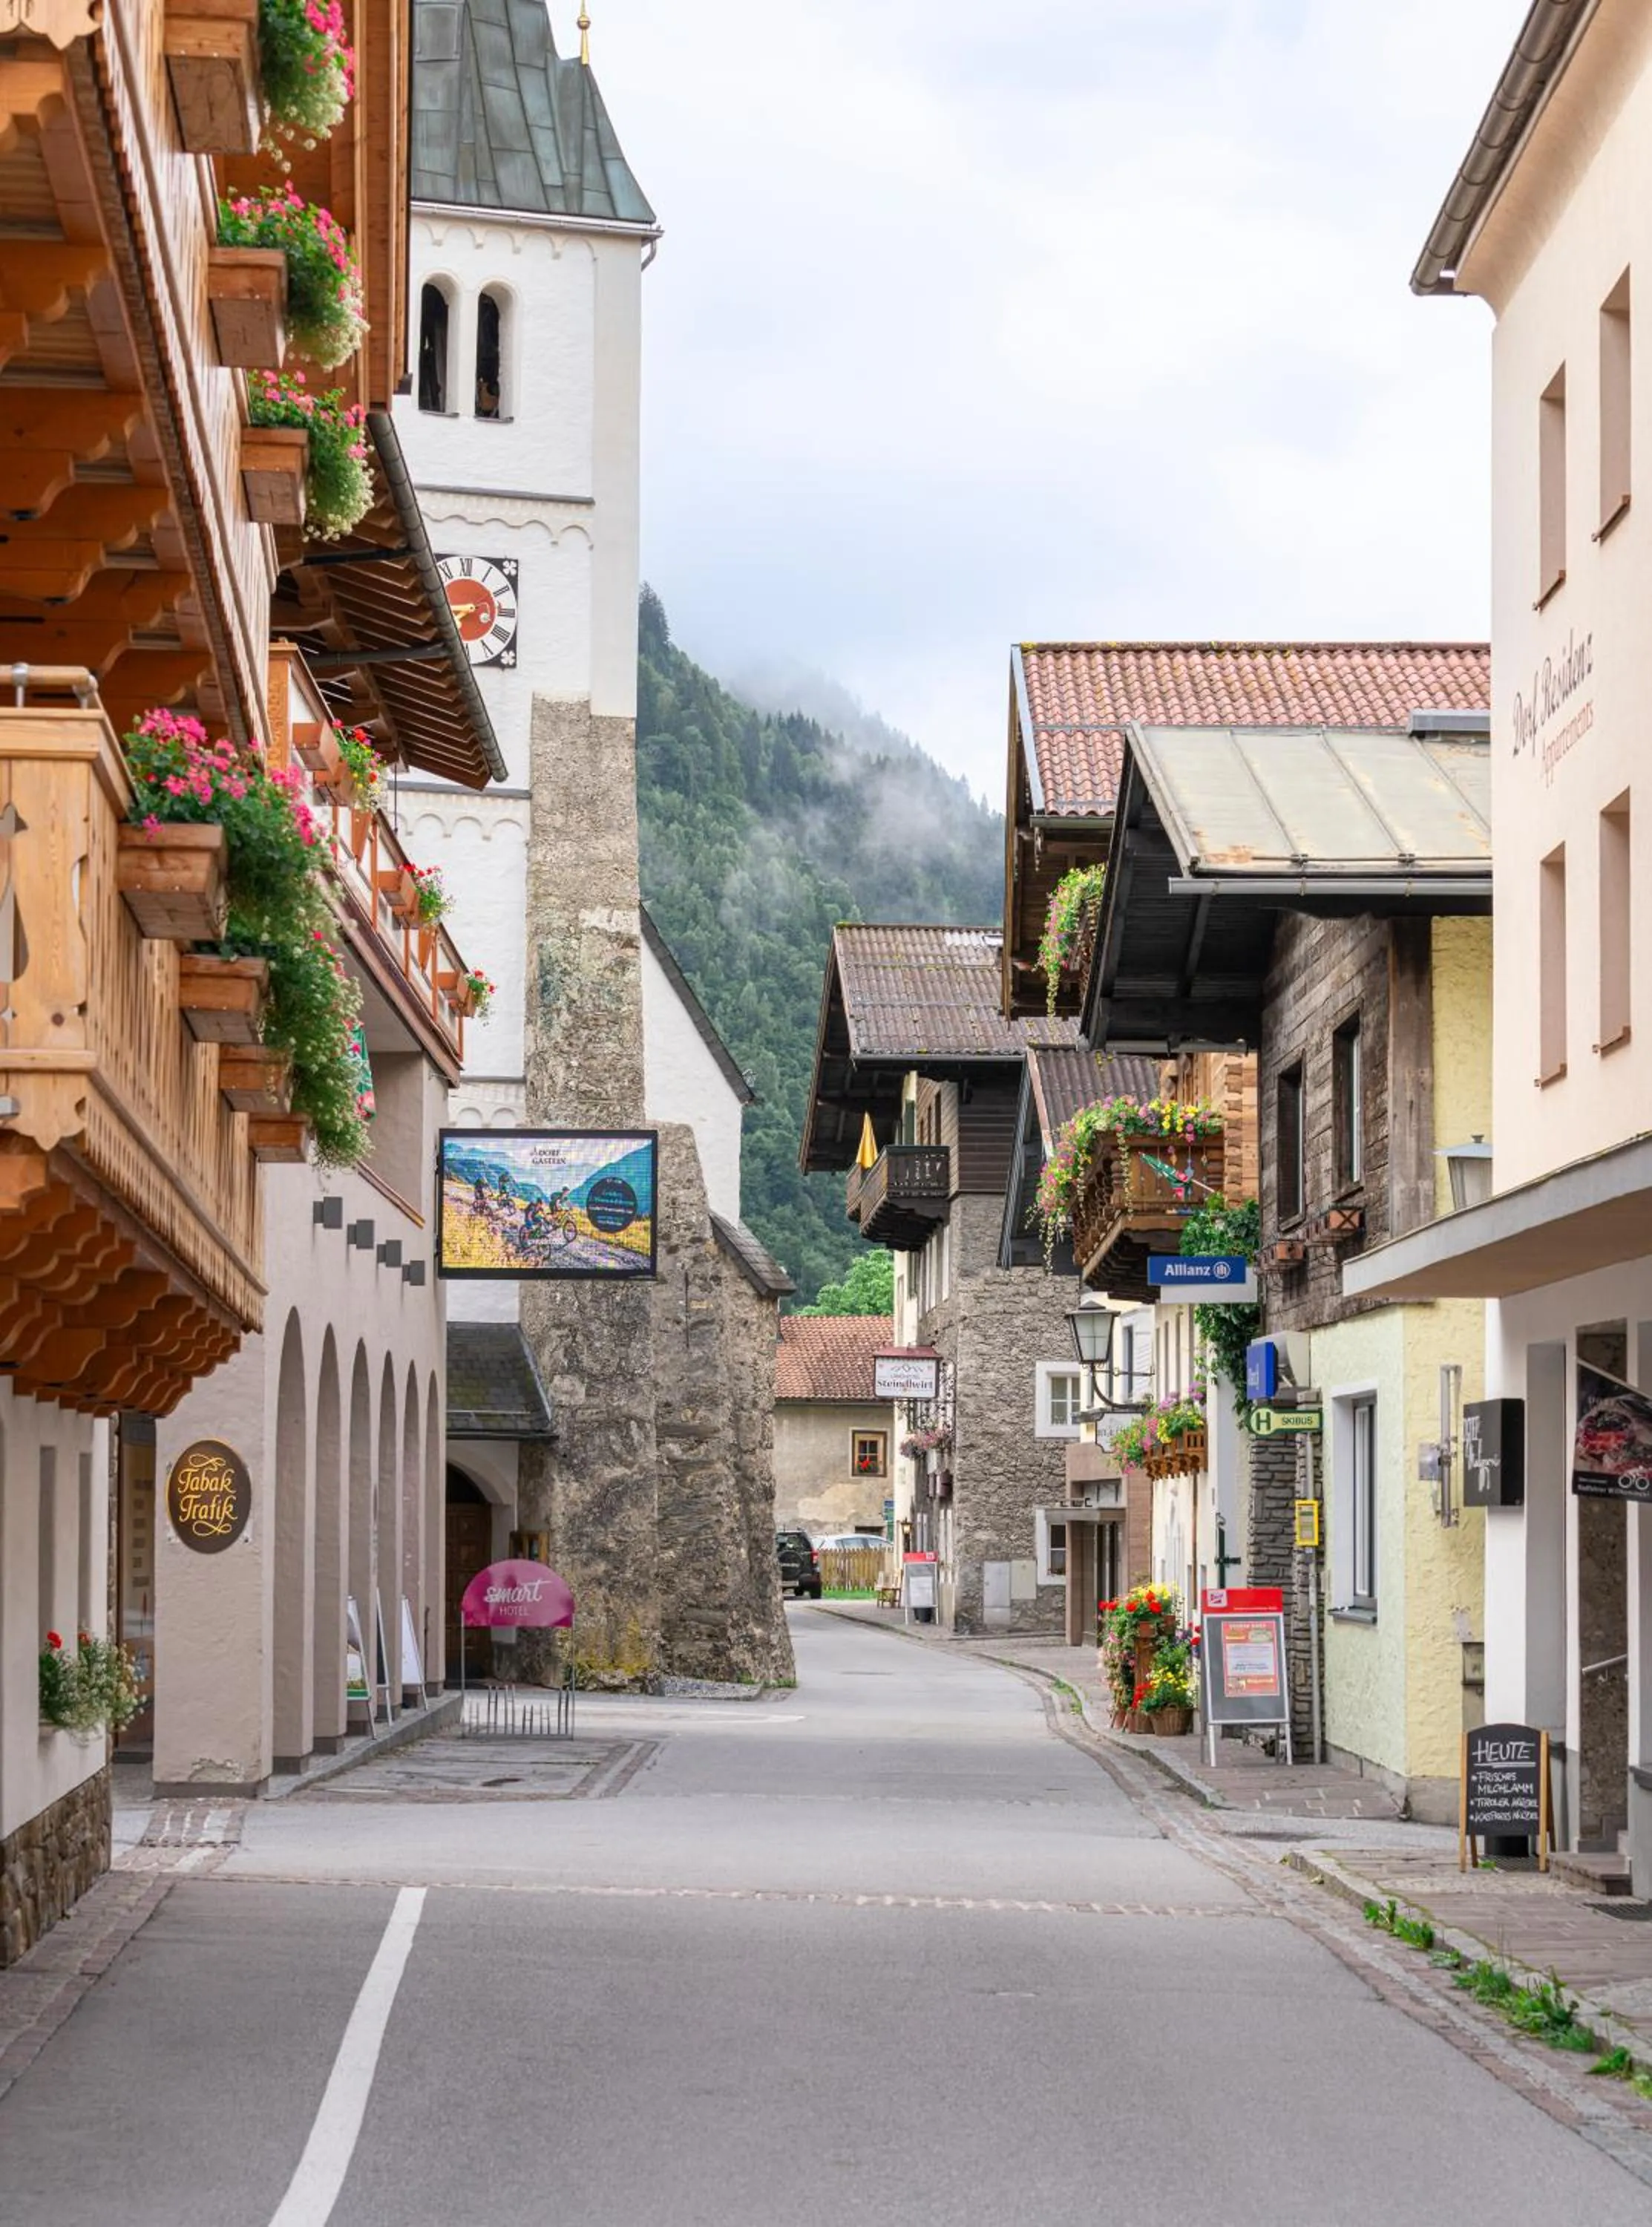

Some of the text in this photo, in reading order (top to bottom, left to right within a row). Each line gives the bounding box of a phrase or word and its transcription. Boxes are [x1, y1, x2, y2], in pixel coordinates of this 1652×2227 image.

[1164, 1264, 1211, 1277] Allianz
[1256, 1411, 1313, 1431] H SKIBUS
[177, 1468, 237, 1494] Tabak
[179, 1494, 238, 1523] Trafik
[484, 1579, 552, 1603] smart
[499, 1606, 529, 1616] HOTEL
[1472, 1739, 1535, 1763] HEUTE
